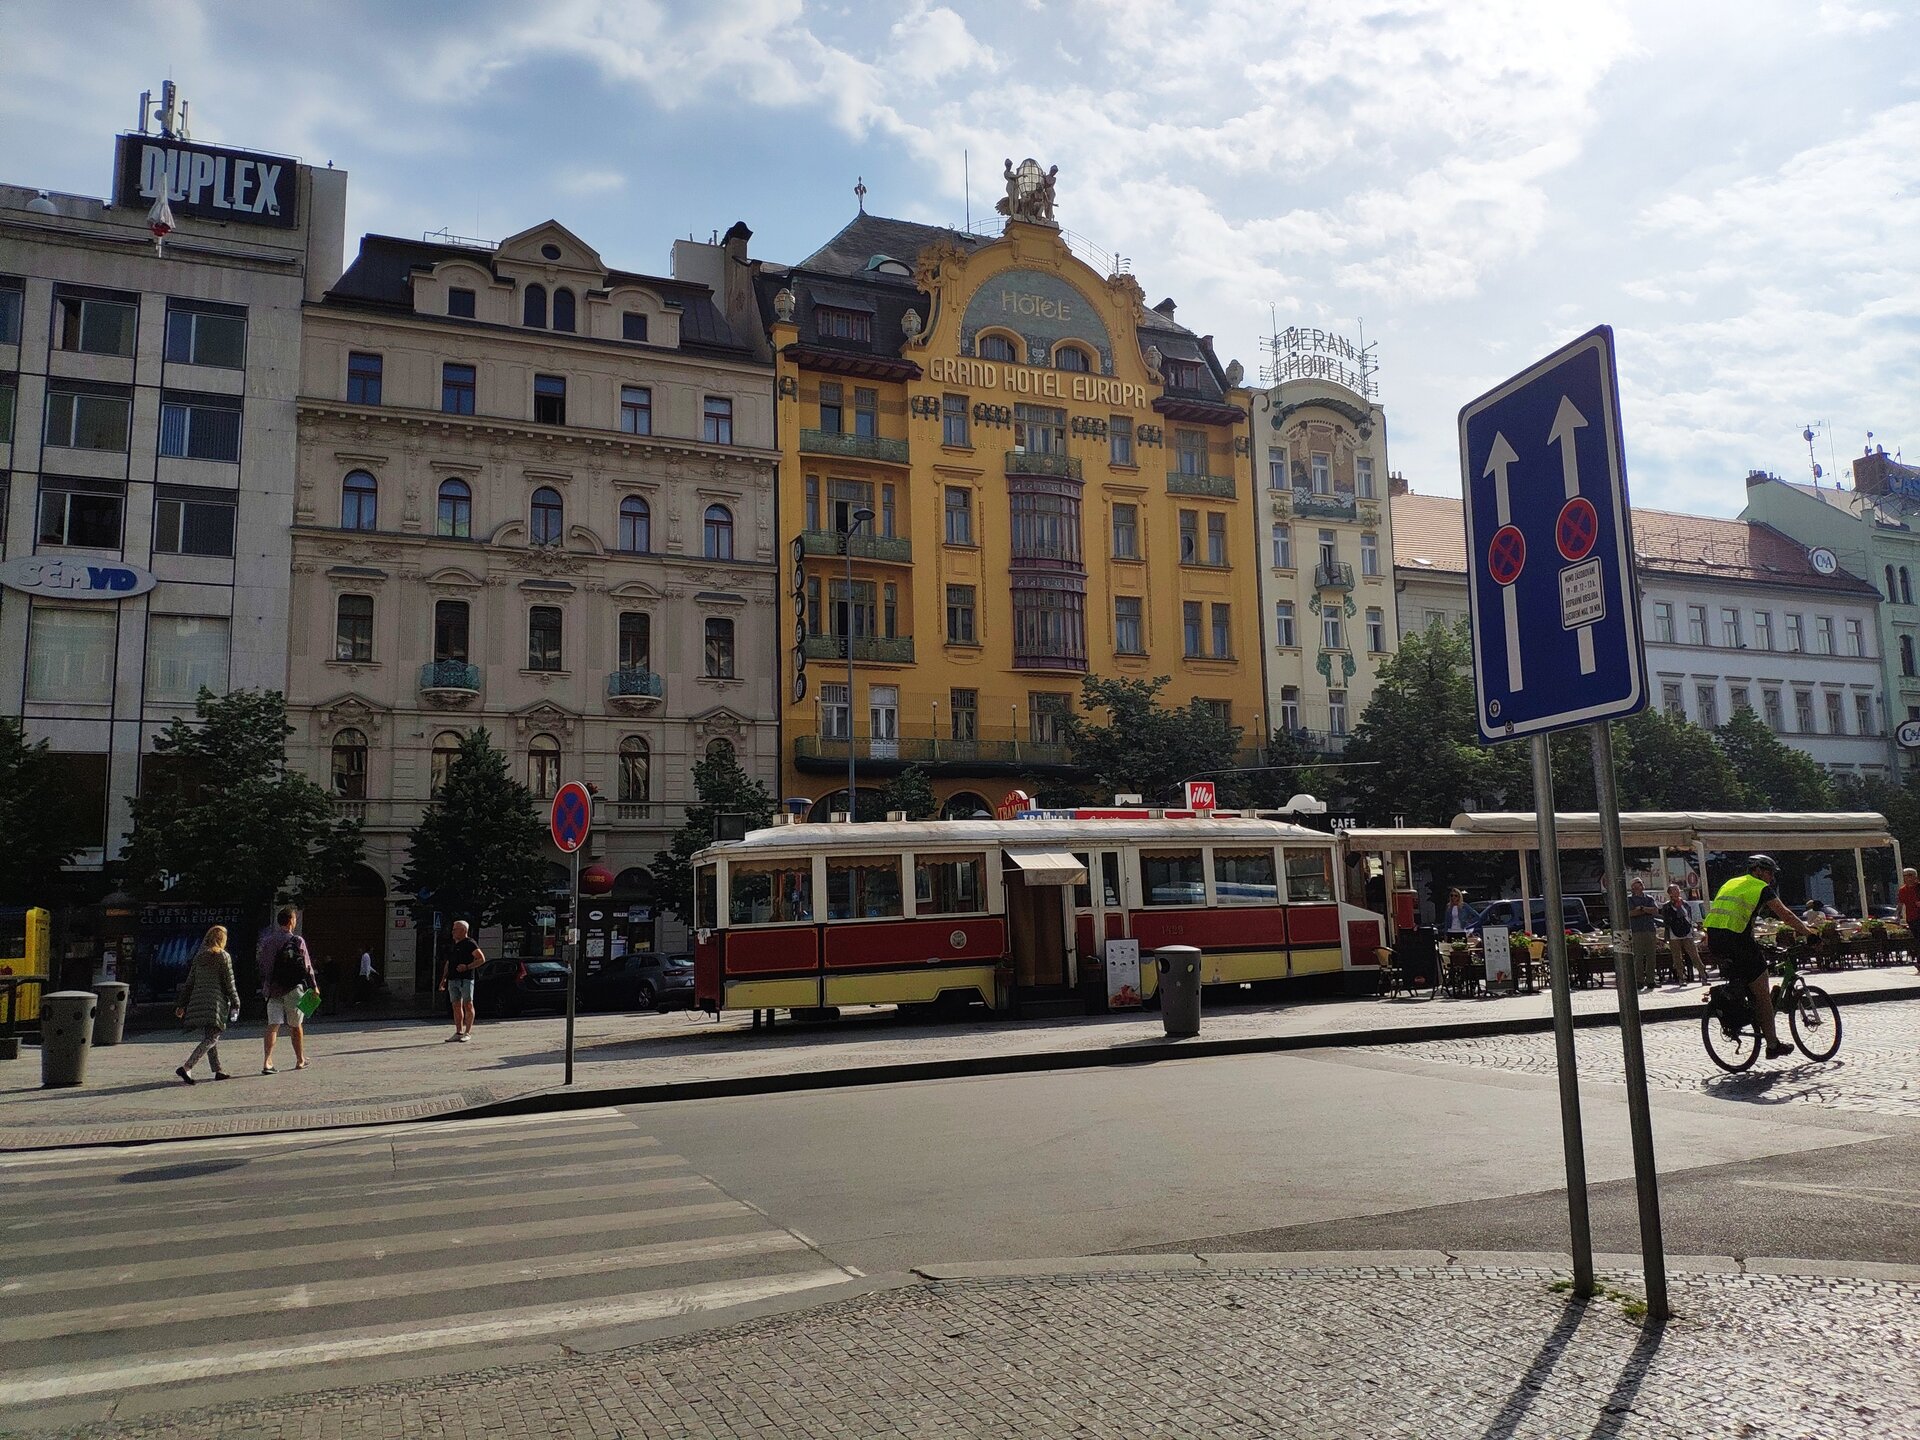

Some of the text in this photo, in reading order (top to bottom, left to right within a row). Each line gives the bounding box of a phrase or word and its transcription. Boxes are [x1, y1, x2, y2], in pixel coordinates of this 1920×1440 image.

[139, 144, 283, 217] DUPLEX
[1285, 327, 1352, 361] MERAN
[929, 356, 998, 389] GRAND
[1003, 365, 1068, 398] HOTEL
[1286, 354, 1353, 389] HOTEL
[1815, 553, 1835, 569] C&A
[1192, 786, 1213, 807] illy
[1330, 817, 1357, 829] CAFE
[140, 915, 240, 924] CLUB IN EUROPE
